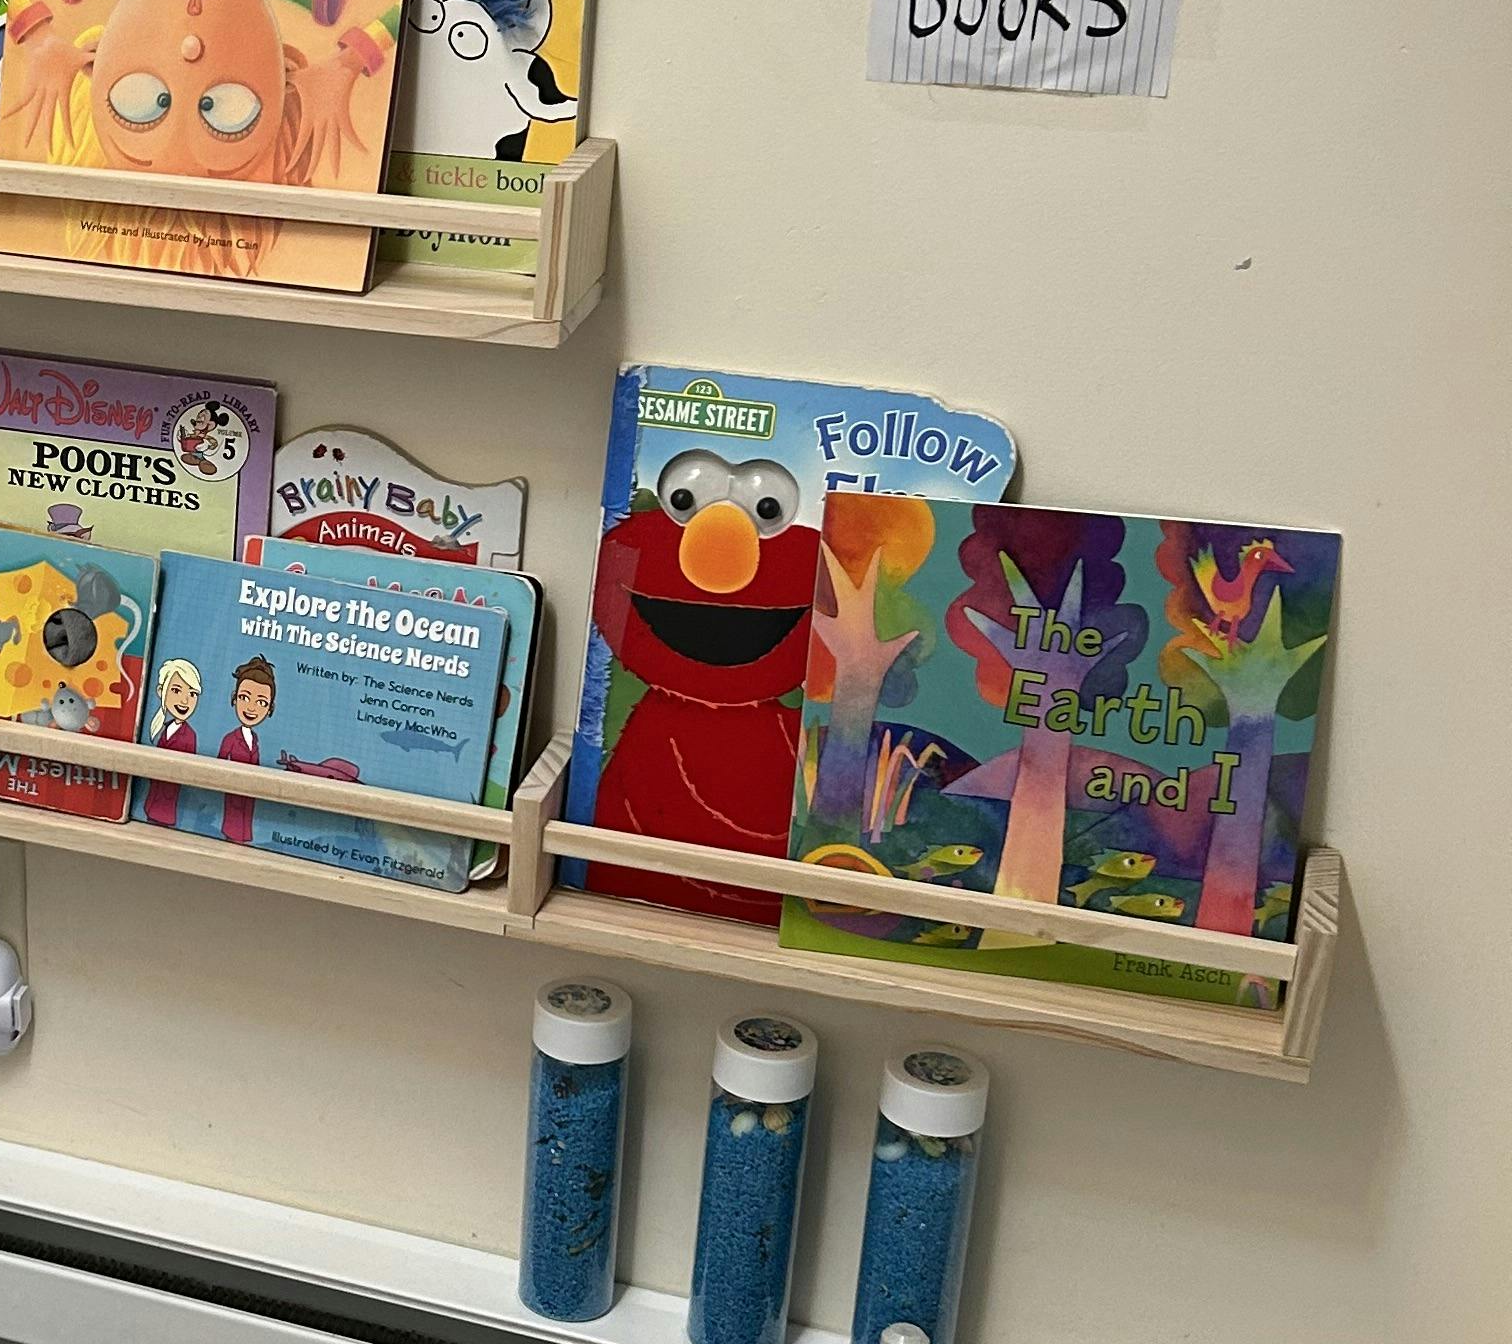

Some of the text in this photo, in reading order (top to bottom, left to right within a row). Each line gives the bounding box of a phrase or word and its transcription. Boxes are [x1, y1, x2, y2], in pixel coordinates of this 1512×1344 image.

[425, 165, 489, 189] tickle
[121, 226, 138, 237] and
[694, 384, 713, 396] 123
[222, 394, 261, 435] LIBRARY
[705, 402, 769, 434] STREET
[31, 441, 177, 486] POOH'S
[222, 438, 237, 461] 5
[814, 408, 1002, 485] Follow
[7, 468, 200, 510] NEW CLOTHES
[277, 471, 483, 540] Brainy Baby
[318, 518, 418, 558] Animals
[238, 579, 341, 623] Explore
[346, 599, 393, 633] the
[394, 609, 480, 650] Ocean
[1010, 605, 1104, 657] The
[240, 616, 471, 679] with The Science Nerds
[296, 661, 339, 682] Written
[363, 676, 386, 691] The
[387, 681, 435, 701] Science
[435, 690, 474, 709] Nerds
[359, 693, 389, 710] Jenn
[356, 709, 403, 733] Lindsey
[1003, 668, 1207, 747] Earth
[7, 777, 39, 796] THE
[1085, 751, 1242, 815] and I
[271, 831, 330, 854] Illustrated
[350, 849, 380, 866] Evan
[382, 855, 445, 882] Fitzgerald
[1113, 952, 1232, 985] Frank Asch
